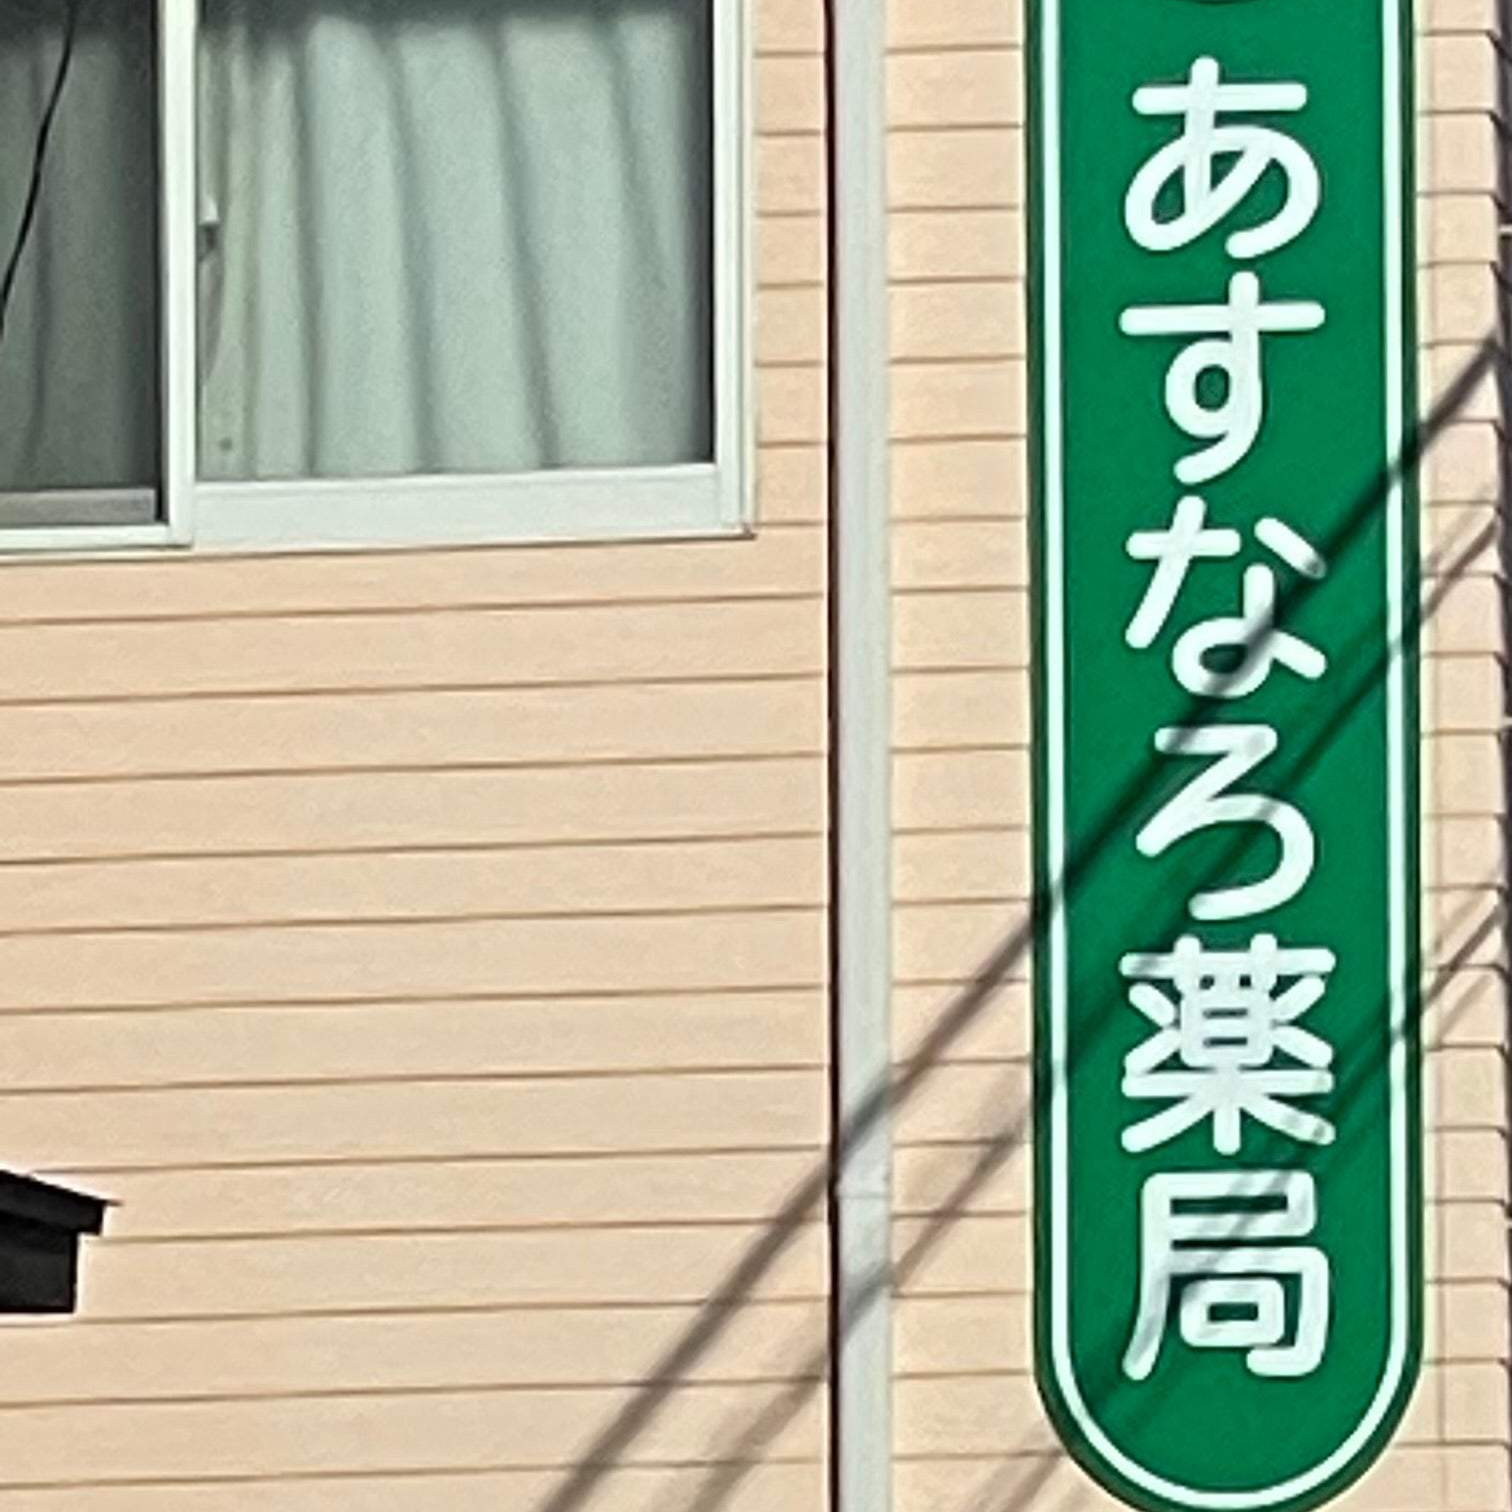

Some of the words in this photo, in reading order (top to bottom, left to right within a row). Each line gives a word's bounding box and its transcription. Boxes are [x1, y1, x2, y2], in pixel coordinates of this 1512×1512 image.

[1119, 55, 1336, 1382] あすなろ薬局
